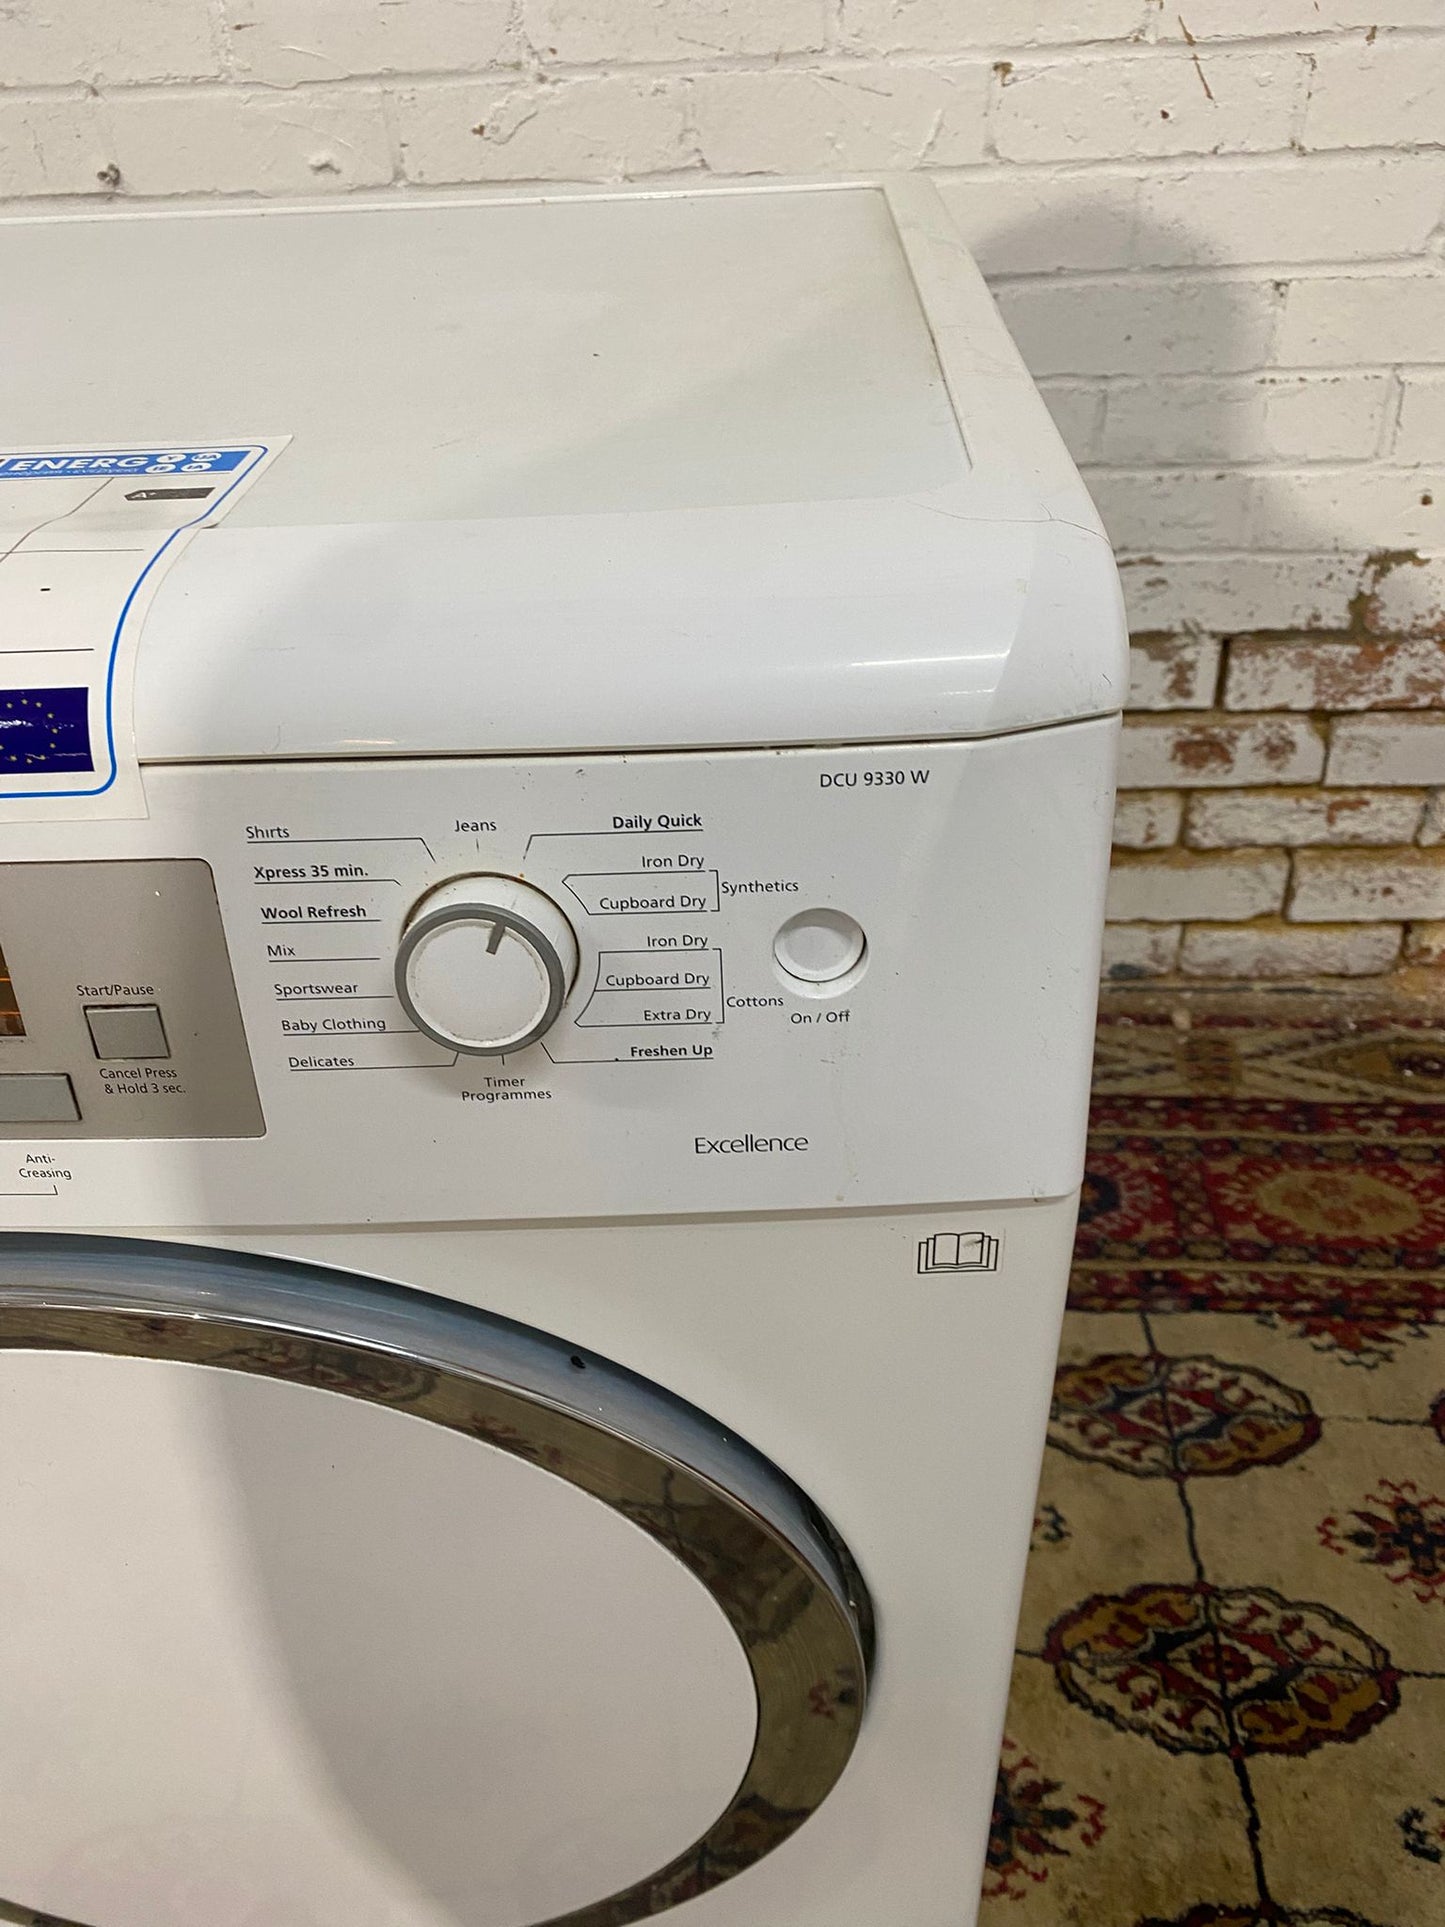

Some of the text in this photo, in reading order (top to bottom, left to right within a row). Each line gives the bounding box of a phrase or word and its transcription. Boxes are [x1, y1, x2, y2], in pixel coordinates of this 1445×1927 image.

[8, 456, 149, 471] ENERG
[820, 770, 930, 788] DCU 9330 W
[455, 819, 497, 833] Jeans
[612, 813, 702, 831] Daily Quick
[246, 826, 290, 839] Shirts
[641, 854, 704, 870] Iron Dry
[254, 864, 369, 880] Xpress 35 min.
[721, 880, 799, 895] Synthetics
[600, 894, 706, 910] Cupboard Dry
[261, 905, 366, 919] Wool Refresh
[647, 934, 708, 950] Iron Dry
[267, 944, 296, 957] Mix
[606, 972, 710, 988] Cupboard Dry
[76, 984, 154, 997] Start/Pause
[274, 982, 358, 997] Sportswear
[726, 995, 784, 1008] Cottons
[644, 1008, 712, 1023] Extra Dry
[790, 1010, 850, 1024] On / Off
[281, 1018, 386, 1033] Baby Clothing
[630, 1044, 713, 1059] Freshen Up
[288, 1055, 355, 1068] Delicates
[99, 1067, 177, 1079] Cancel Press
[104, 1082, 186, 1094] & Hold 3 sec.
[484, 1075, 525, 1088] Timer
[462, 1089, 552, 1104] Programmes
[694, 1134, 809, 1154] Excellence
[26, 1153, 56, 1164] Anti-
[19, 1168, 72, 1181] Creasing
